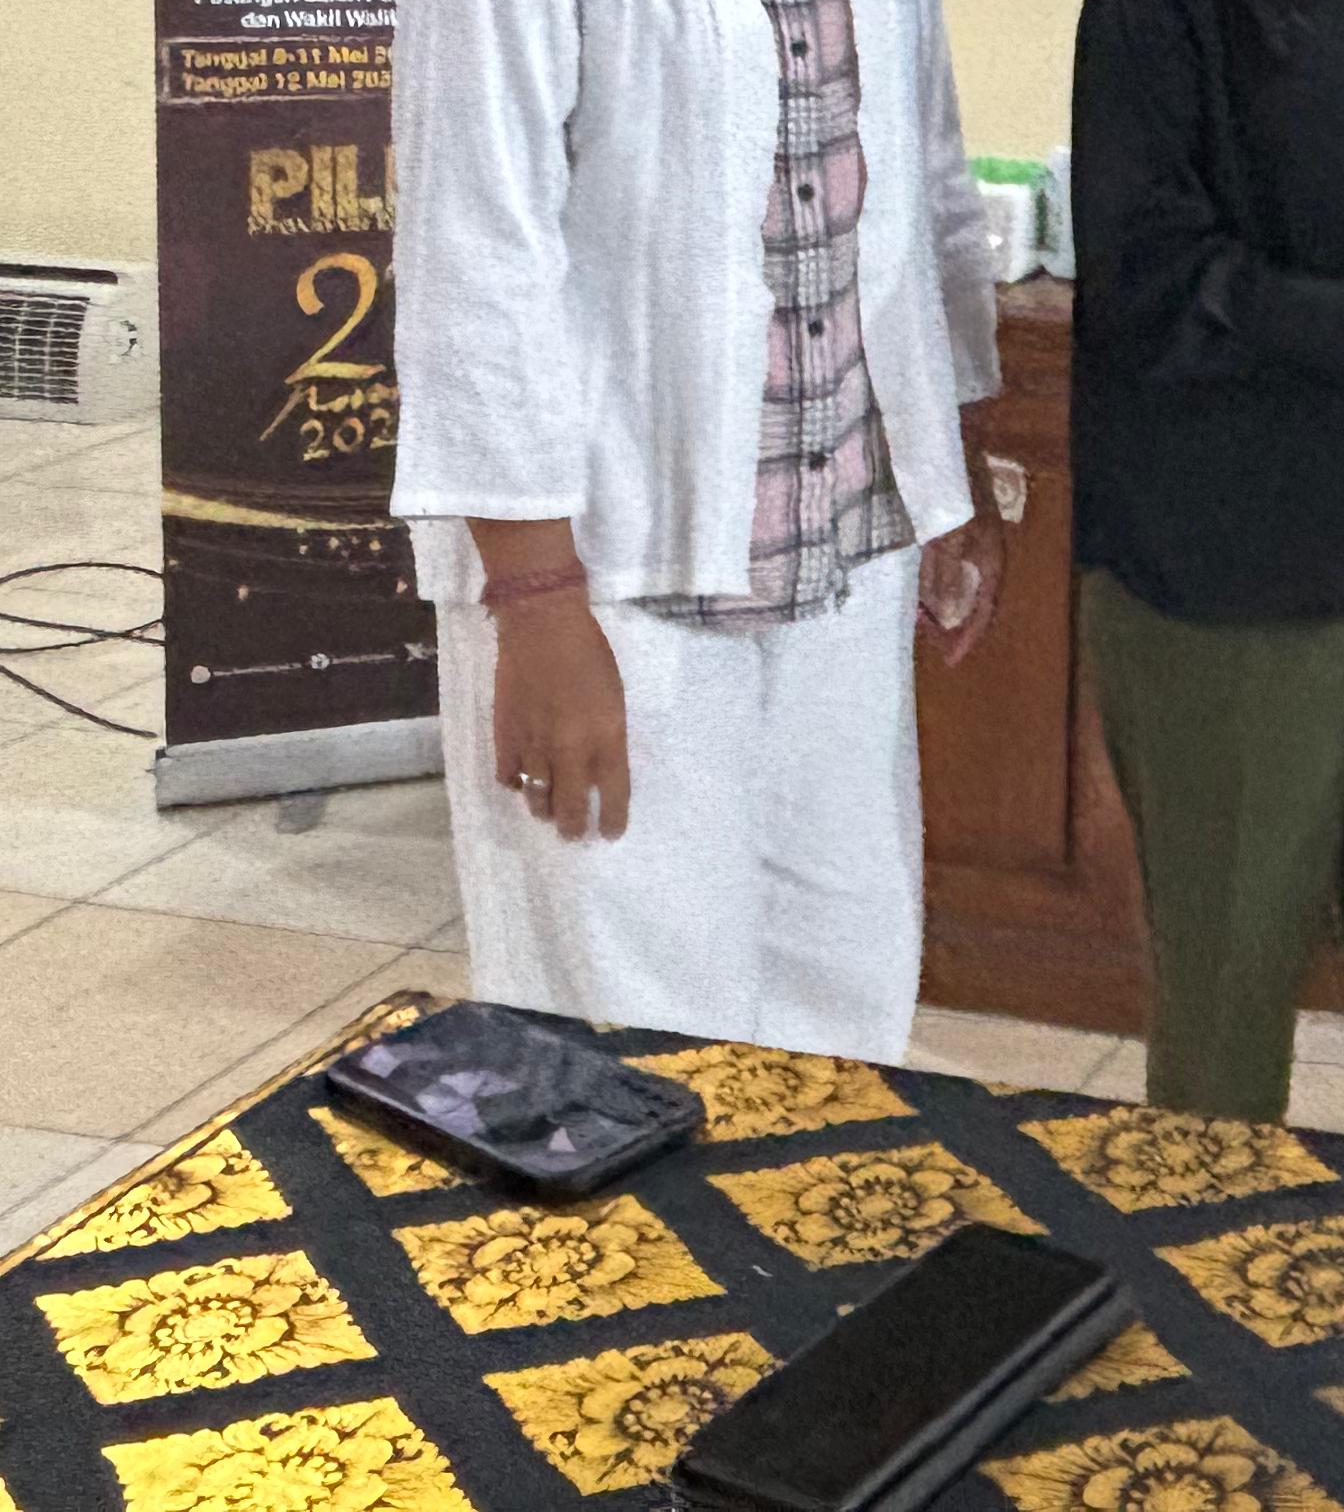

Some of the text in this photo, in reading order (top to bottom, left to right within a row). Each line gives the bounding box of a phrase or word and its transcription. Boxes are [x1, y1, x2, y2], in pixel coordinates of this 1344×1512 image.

[240, 12, 281, 30] dan
[284, 9, 342, 29] Wakil
[181, 45, 267, 71] Tanggal
[181, 71, 268, 96] Tanggal
[306, 70, 346, 91] Mei
